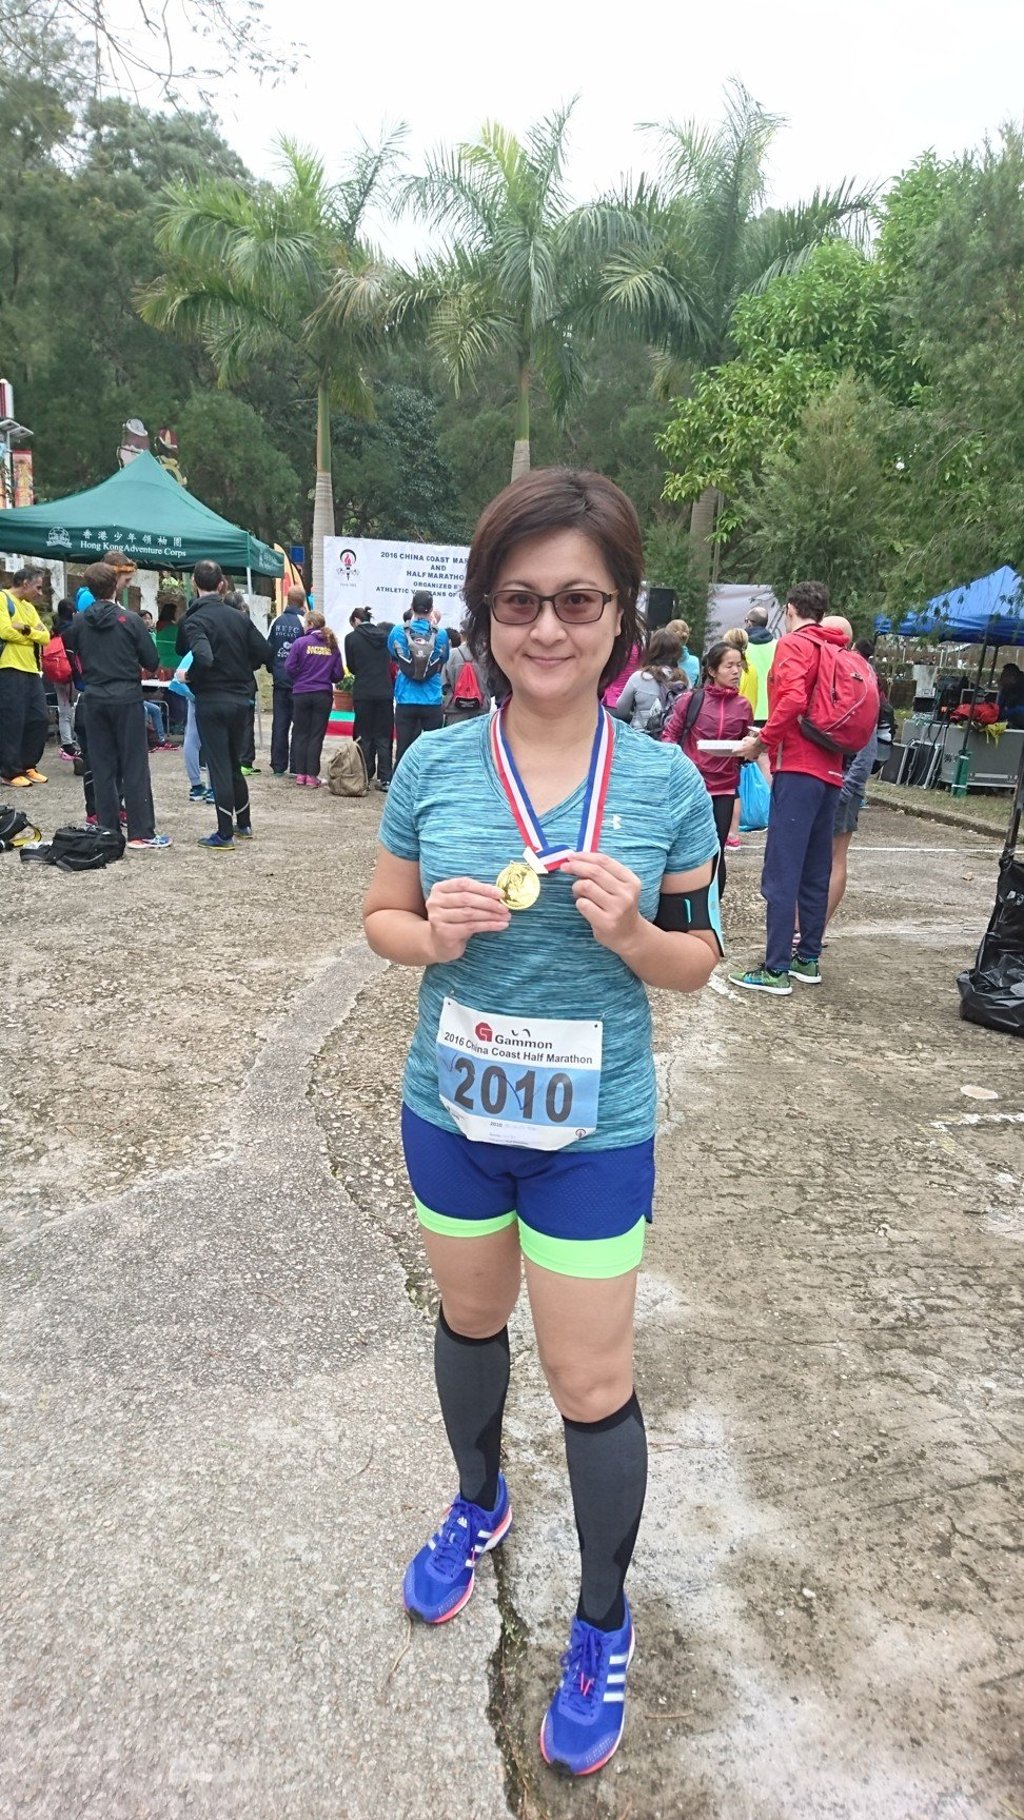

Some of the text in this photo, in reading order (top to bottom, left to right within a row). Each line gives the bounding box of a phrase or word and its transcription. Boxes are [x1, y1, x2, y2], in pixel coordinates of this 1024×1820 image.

[80, 540, 187, 558] Hong Kong Adventure Corps
[380, 551, 398, 559] 2016
[399, 553, 424, 561] CHINA
[406, 570, 465, 580] HALF MARATHO
[375, 586, 409, 594] ATHLETIC
[413, 581, 453, 590] ORGANIZED
[494, 1034, 553, 1049] Gammon
[444, 1031, 593, 1065] 2016 China Coast Half Marathon
[453, 1056, 574, 1124] 2010
